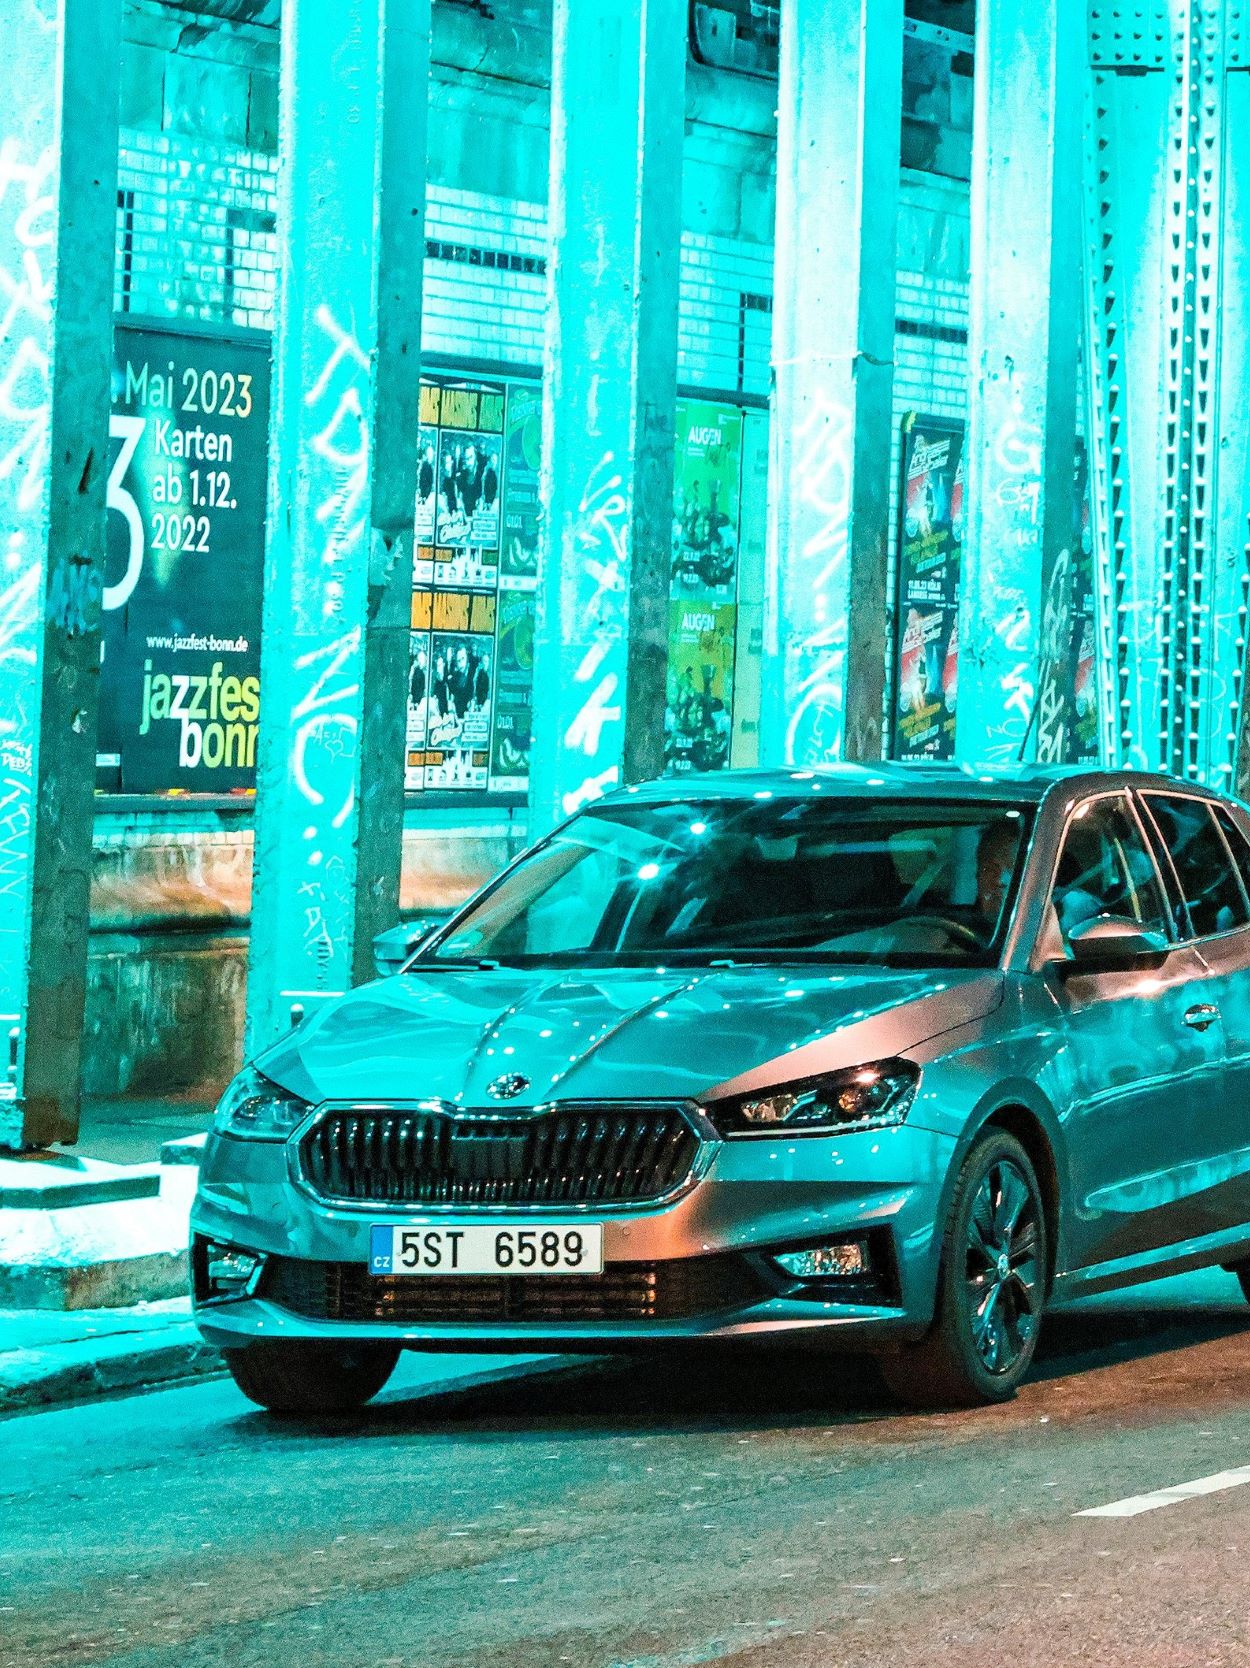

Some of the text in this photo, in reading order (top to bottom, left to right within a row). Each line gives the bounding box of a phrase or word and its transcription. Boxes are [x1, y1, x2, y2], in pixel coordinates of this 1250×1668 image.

[125, 360, 252, 418] Mai 2023
[154, 418, 233, 463] Karten
[687, 425, 722, 446] AUGEN
[152, 462, 237, 509] ab 1.12.
[151, 512, 211, 553] 2022
[681, 612, 715, 632] AUGEN
[146, 632, 249, 653] www.jazzfest-bonn.de
[139, 658, 260, 735] jazzfes
[373, 1256, 390, 1268] CZ
[401, 1230, 584, 1269] 5ST 6589
